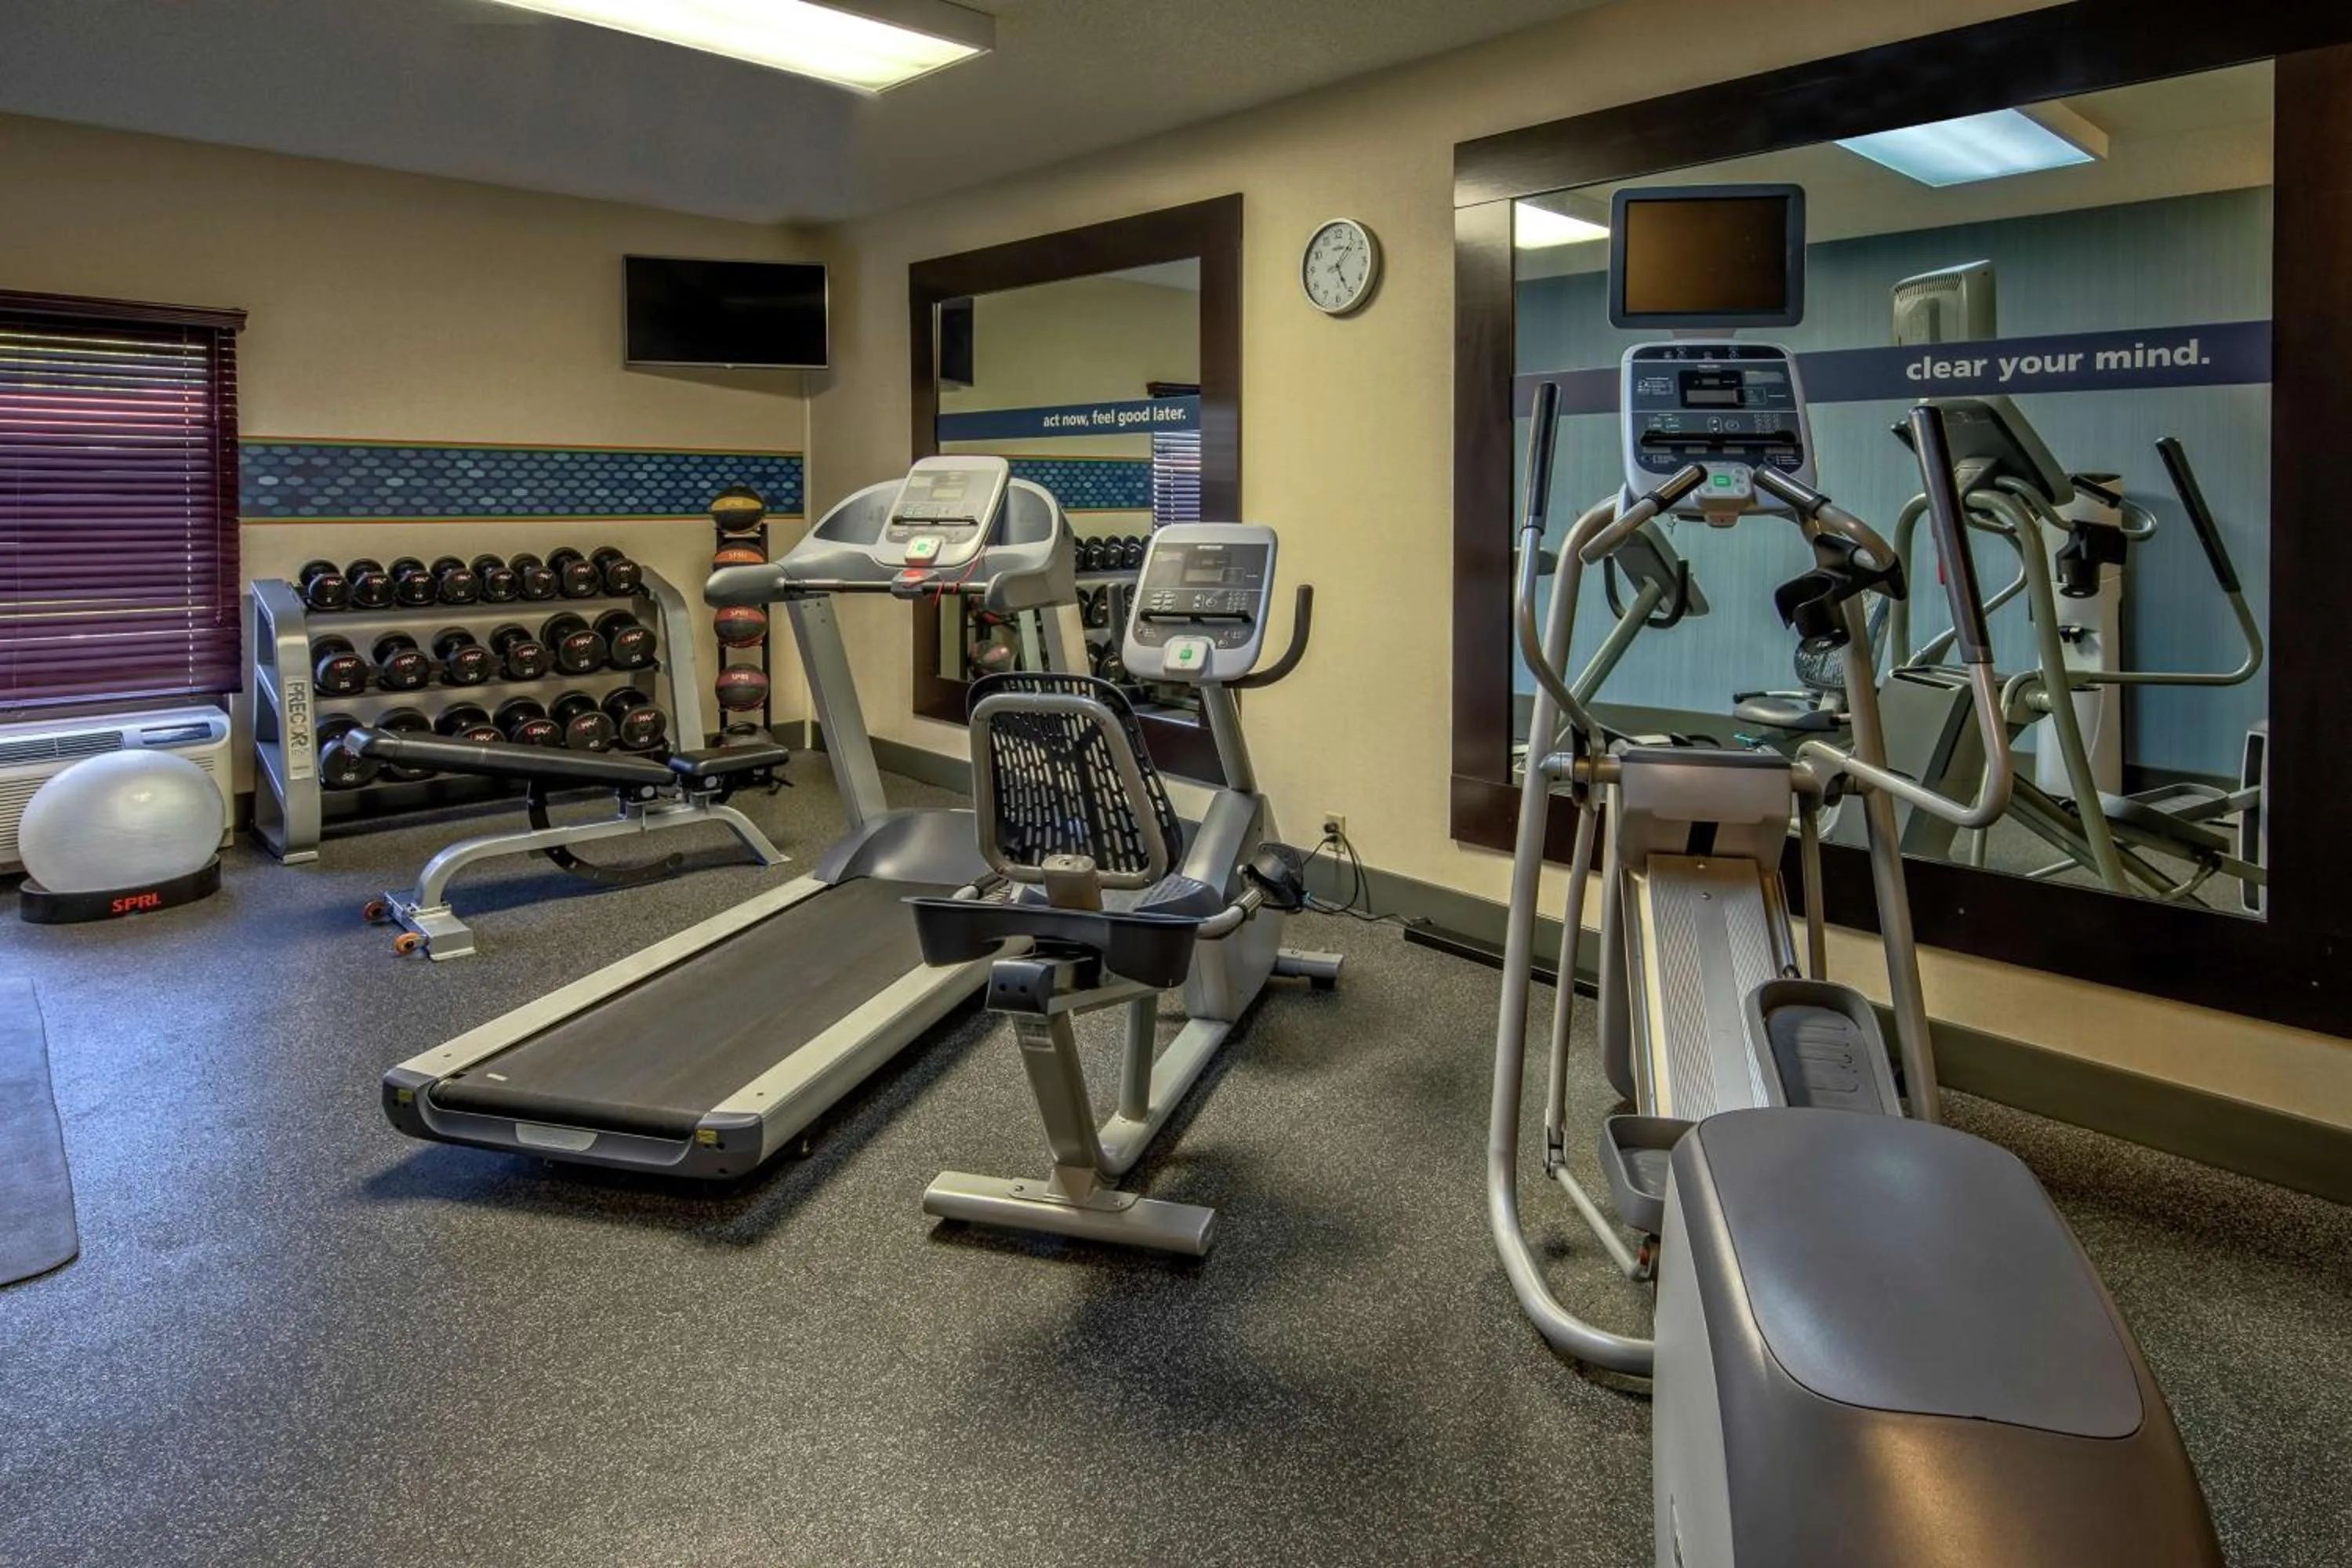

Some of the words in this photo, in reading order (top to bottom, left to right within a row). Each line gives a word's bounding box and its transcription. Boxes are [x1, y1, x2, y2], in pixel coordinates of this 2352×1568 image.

[1906, 356, 1988, 381] clear
[1998, 350, 2085, 383] your
[2096, 338, 2211, 371] mind.
[1043, 415, 1060, 428] act
[1062, 412, 1090, 428] now,
[1092, 408, 1115, 425] feel
[1118, 407, 1150, 427] good
[1153, 405, 1187, 422] later.
